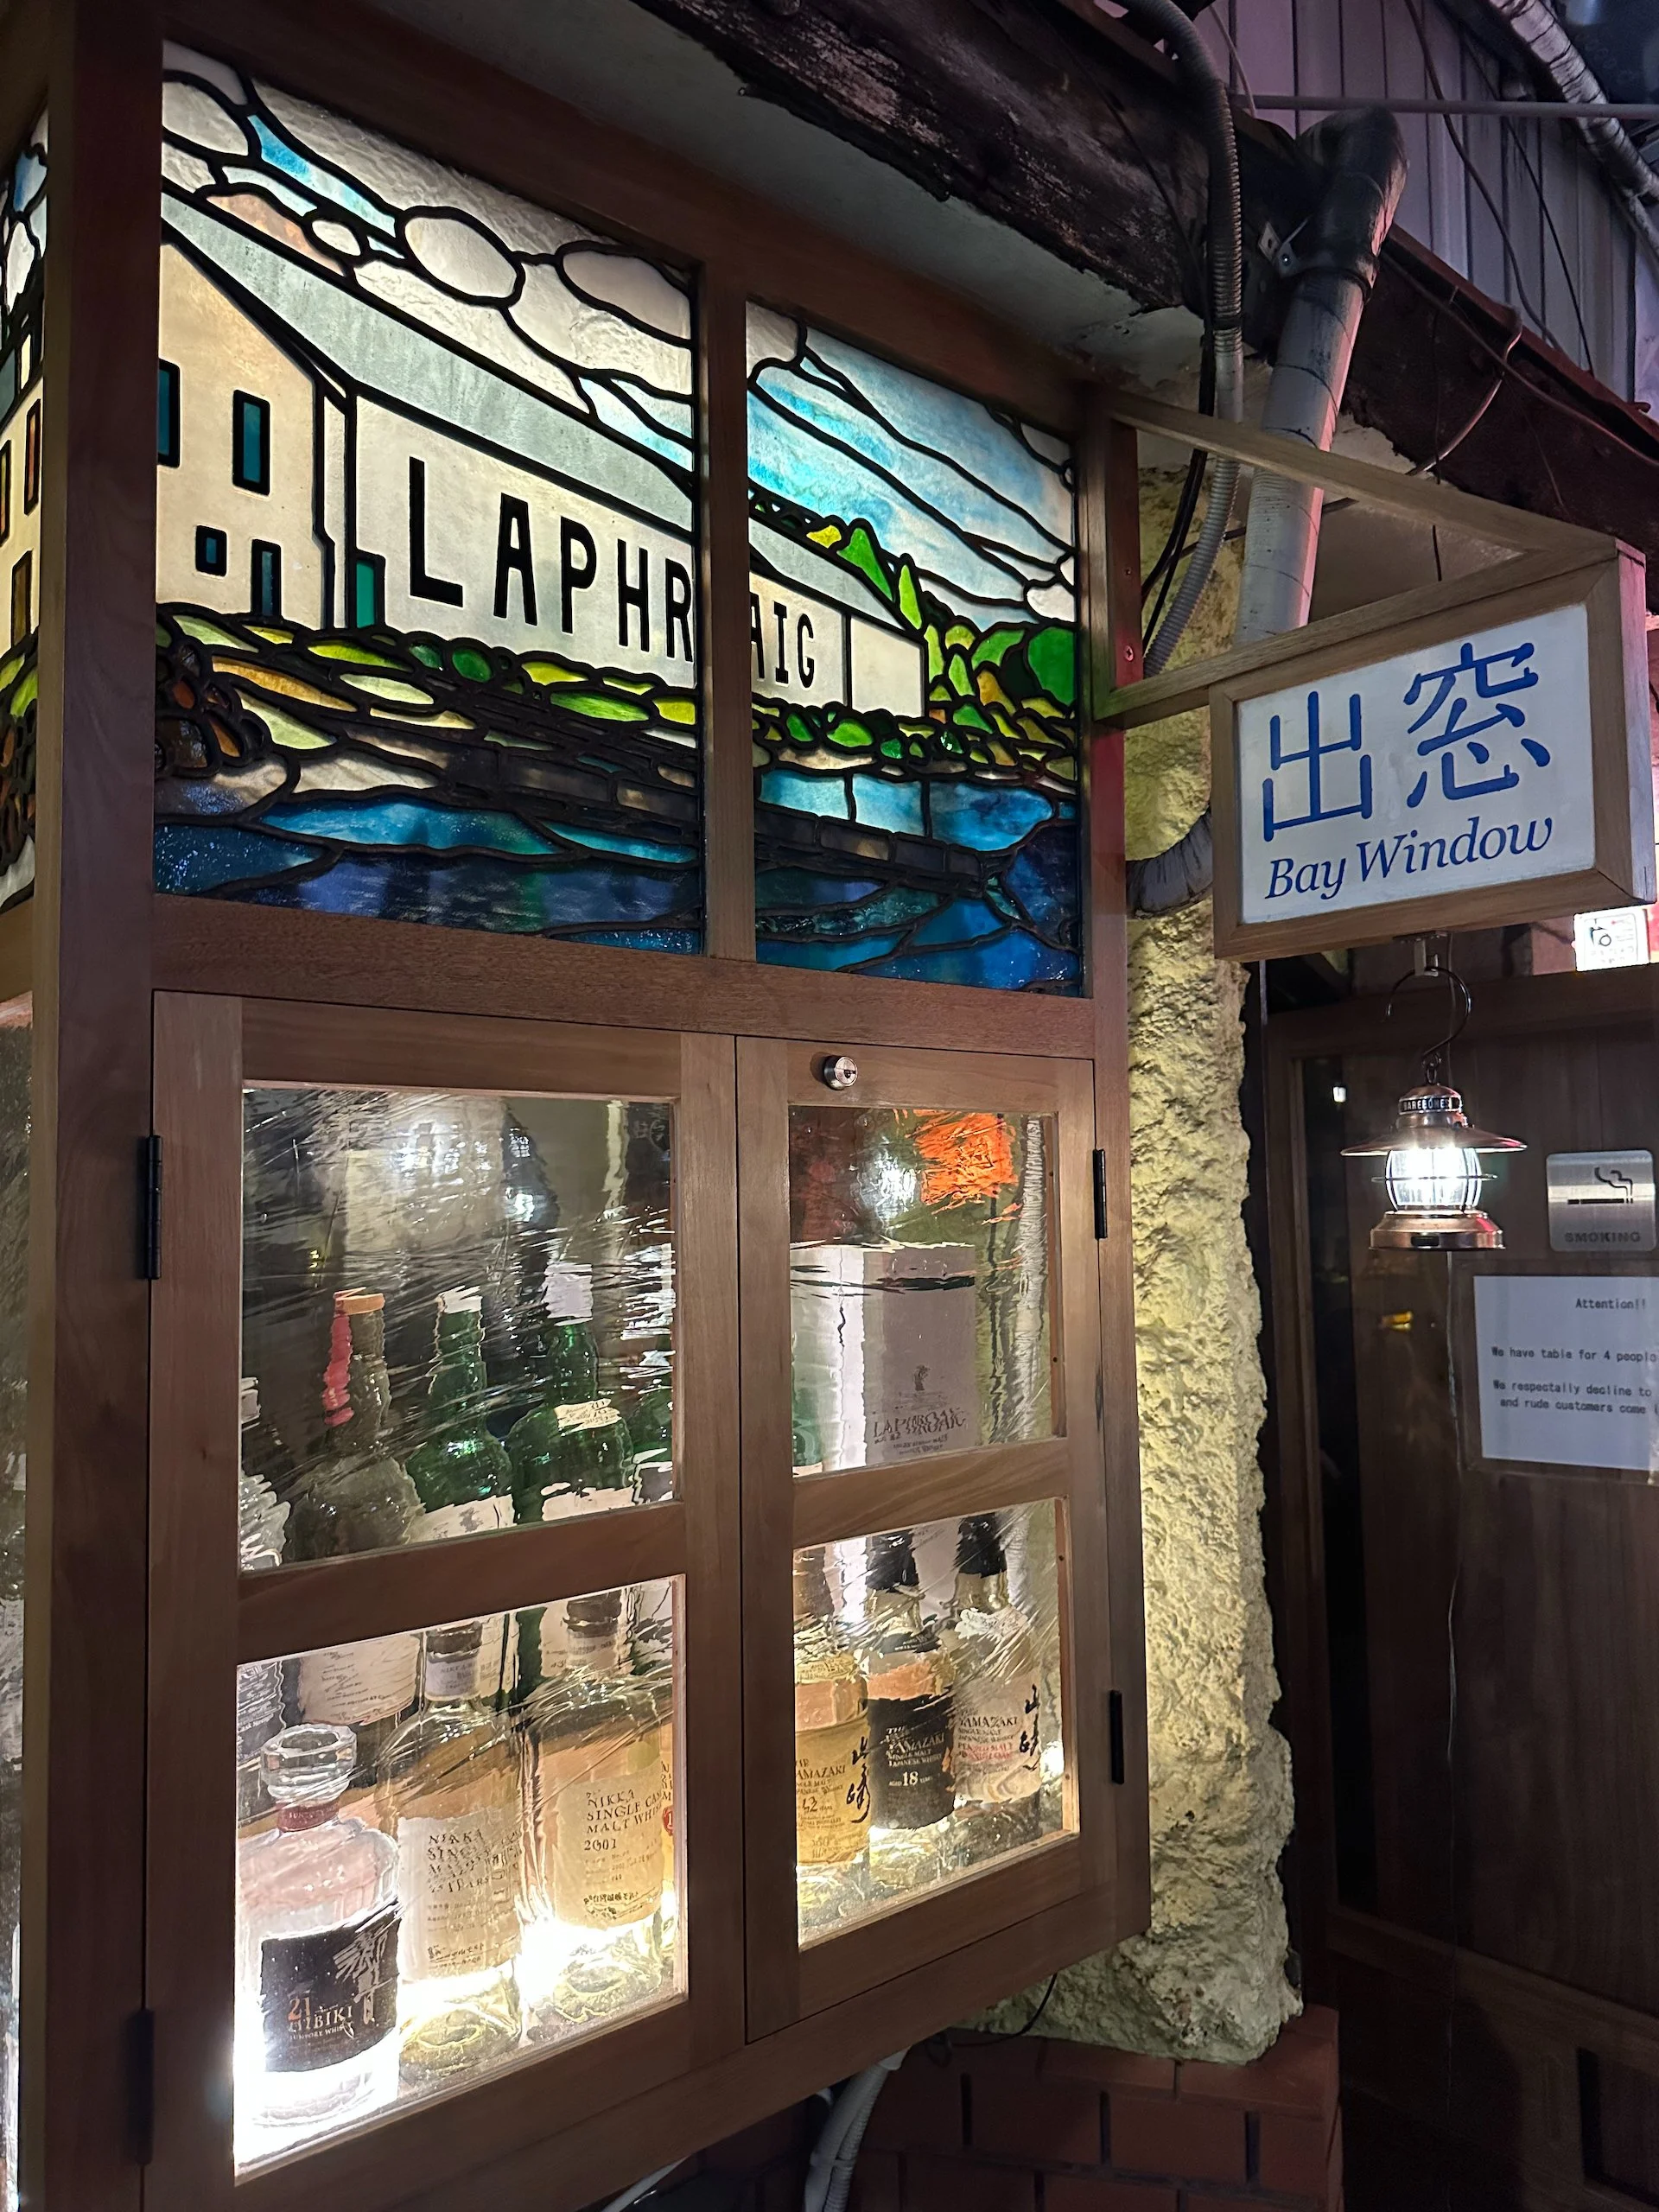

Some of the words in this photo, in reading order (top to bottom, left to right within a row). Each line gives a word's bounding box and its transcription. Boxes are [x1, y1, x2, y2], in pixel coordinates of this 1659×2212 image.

[409, 456, 815, 689] LAPHRAIG
[1262, 642, 1551, 842] 出窓
[1265, 857, 1346, 900] Bay
[1356, 817, 1553, 883] Window
[1564, 1231, 1641, 1243] SMOKING
[1575, 1298, 1646, 1310] Attention!!
[1491, 1346, 1504, 1357] We
[1510, 1347, 1535, 1358] have
[1541, 1348, 1573, 1359] table
[1579, 1349, 1597, 1360] for
[1603, 1350, 1611, 1360] 4
[1493, 1380, 1506, 1390] We
[1586, 1384, 1632, 1396] decline
[1638, 1387, 1652, 1397] to
[1500, 1398, 1519, 1408] and
[1524, 1398, 1549, 1409] rude
[1555, 1400, 1613, 1413] customers
[1618, 1403, 1646, 1414] come
[796, 1764, 846, 1780] AMAZAKI
[902, 1771, 918, 1787] 18
[588, 1802, 642, 1821] SINGLE
[587, 1817, 630, 1834] MALT
[288, 1997, 311, 2021] 21
